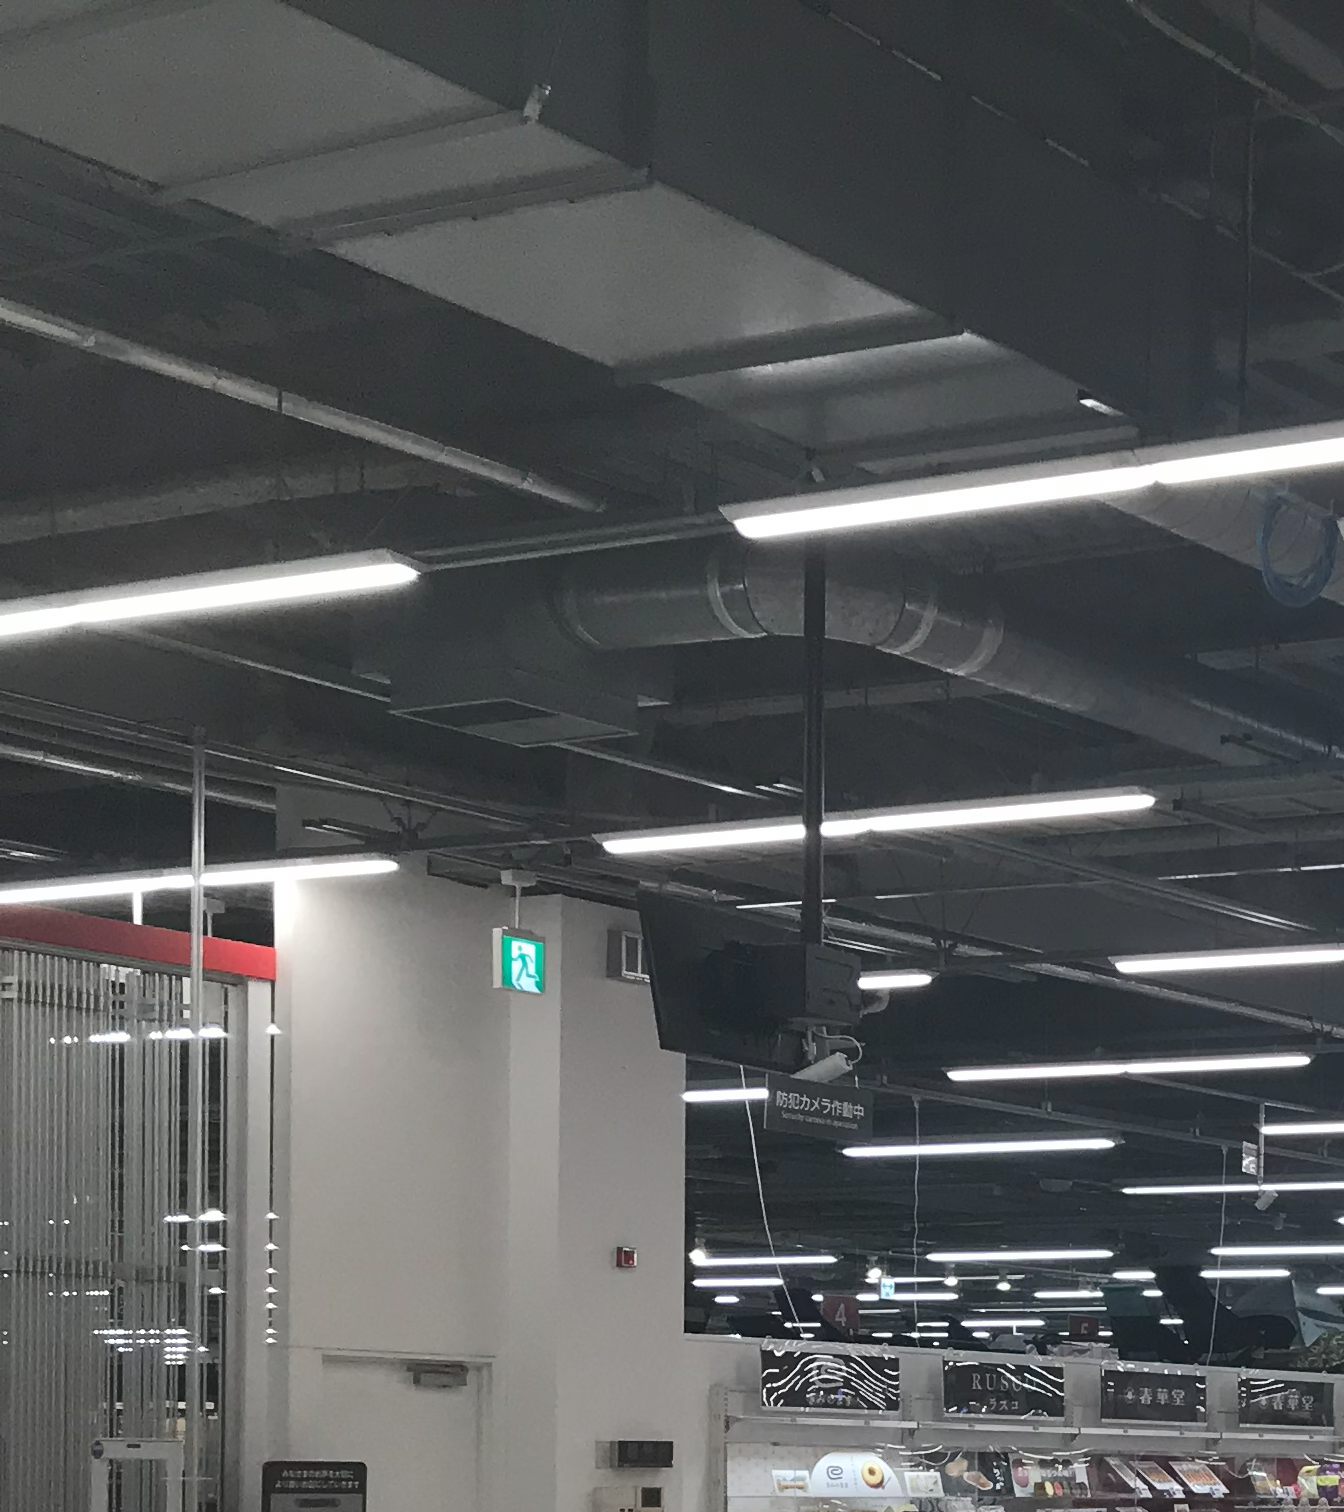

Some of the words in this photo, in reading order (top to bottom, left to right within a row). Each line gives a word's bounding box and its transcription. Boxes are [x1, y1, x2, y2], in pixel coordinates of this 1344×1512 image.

[776, 1090, 865, 1119] 防犯カメラ作動中
[834, 1302, 847, 1327] 4
